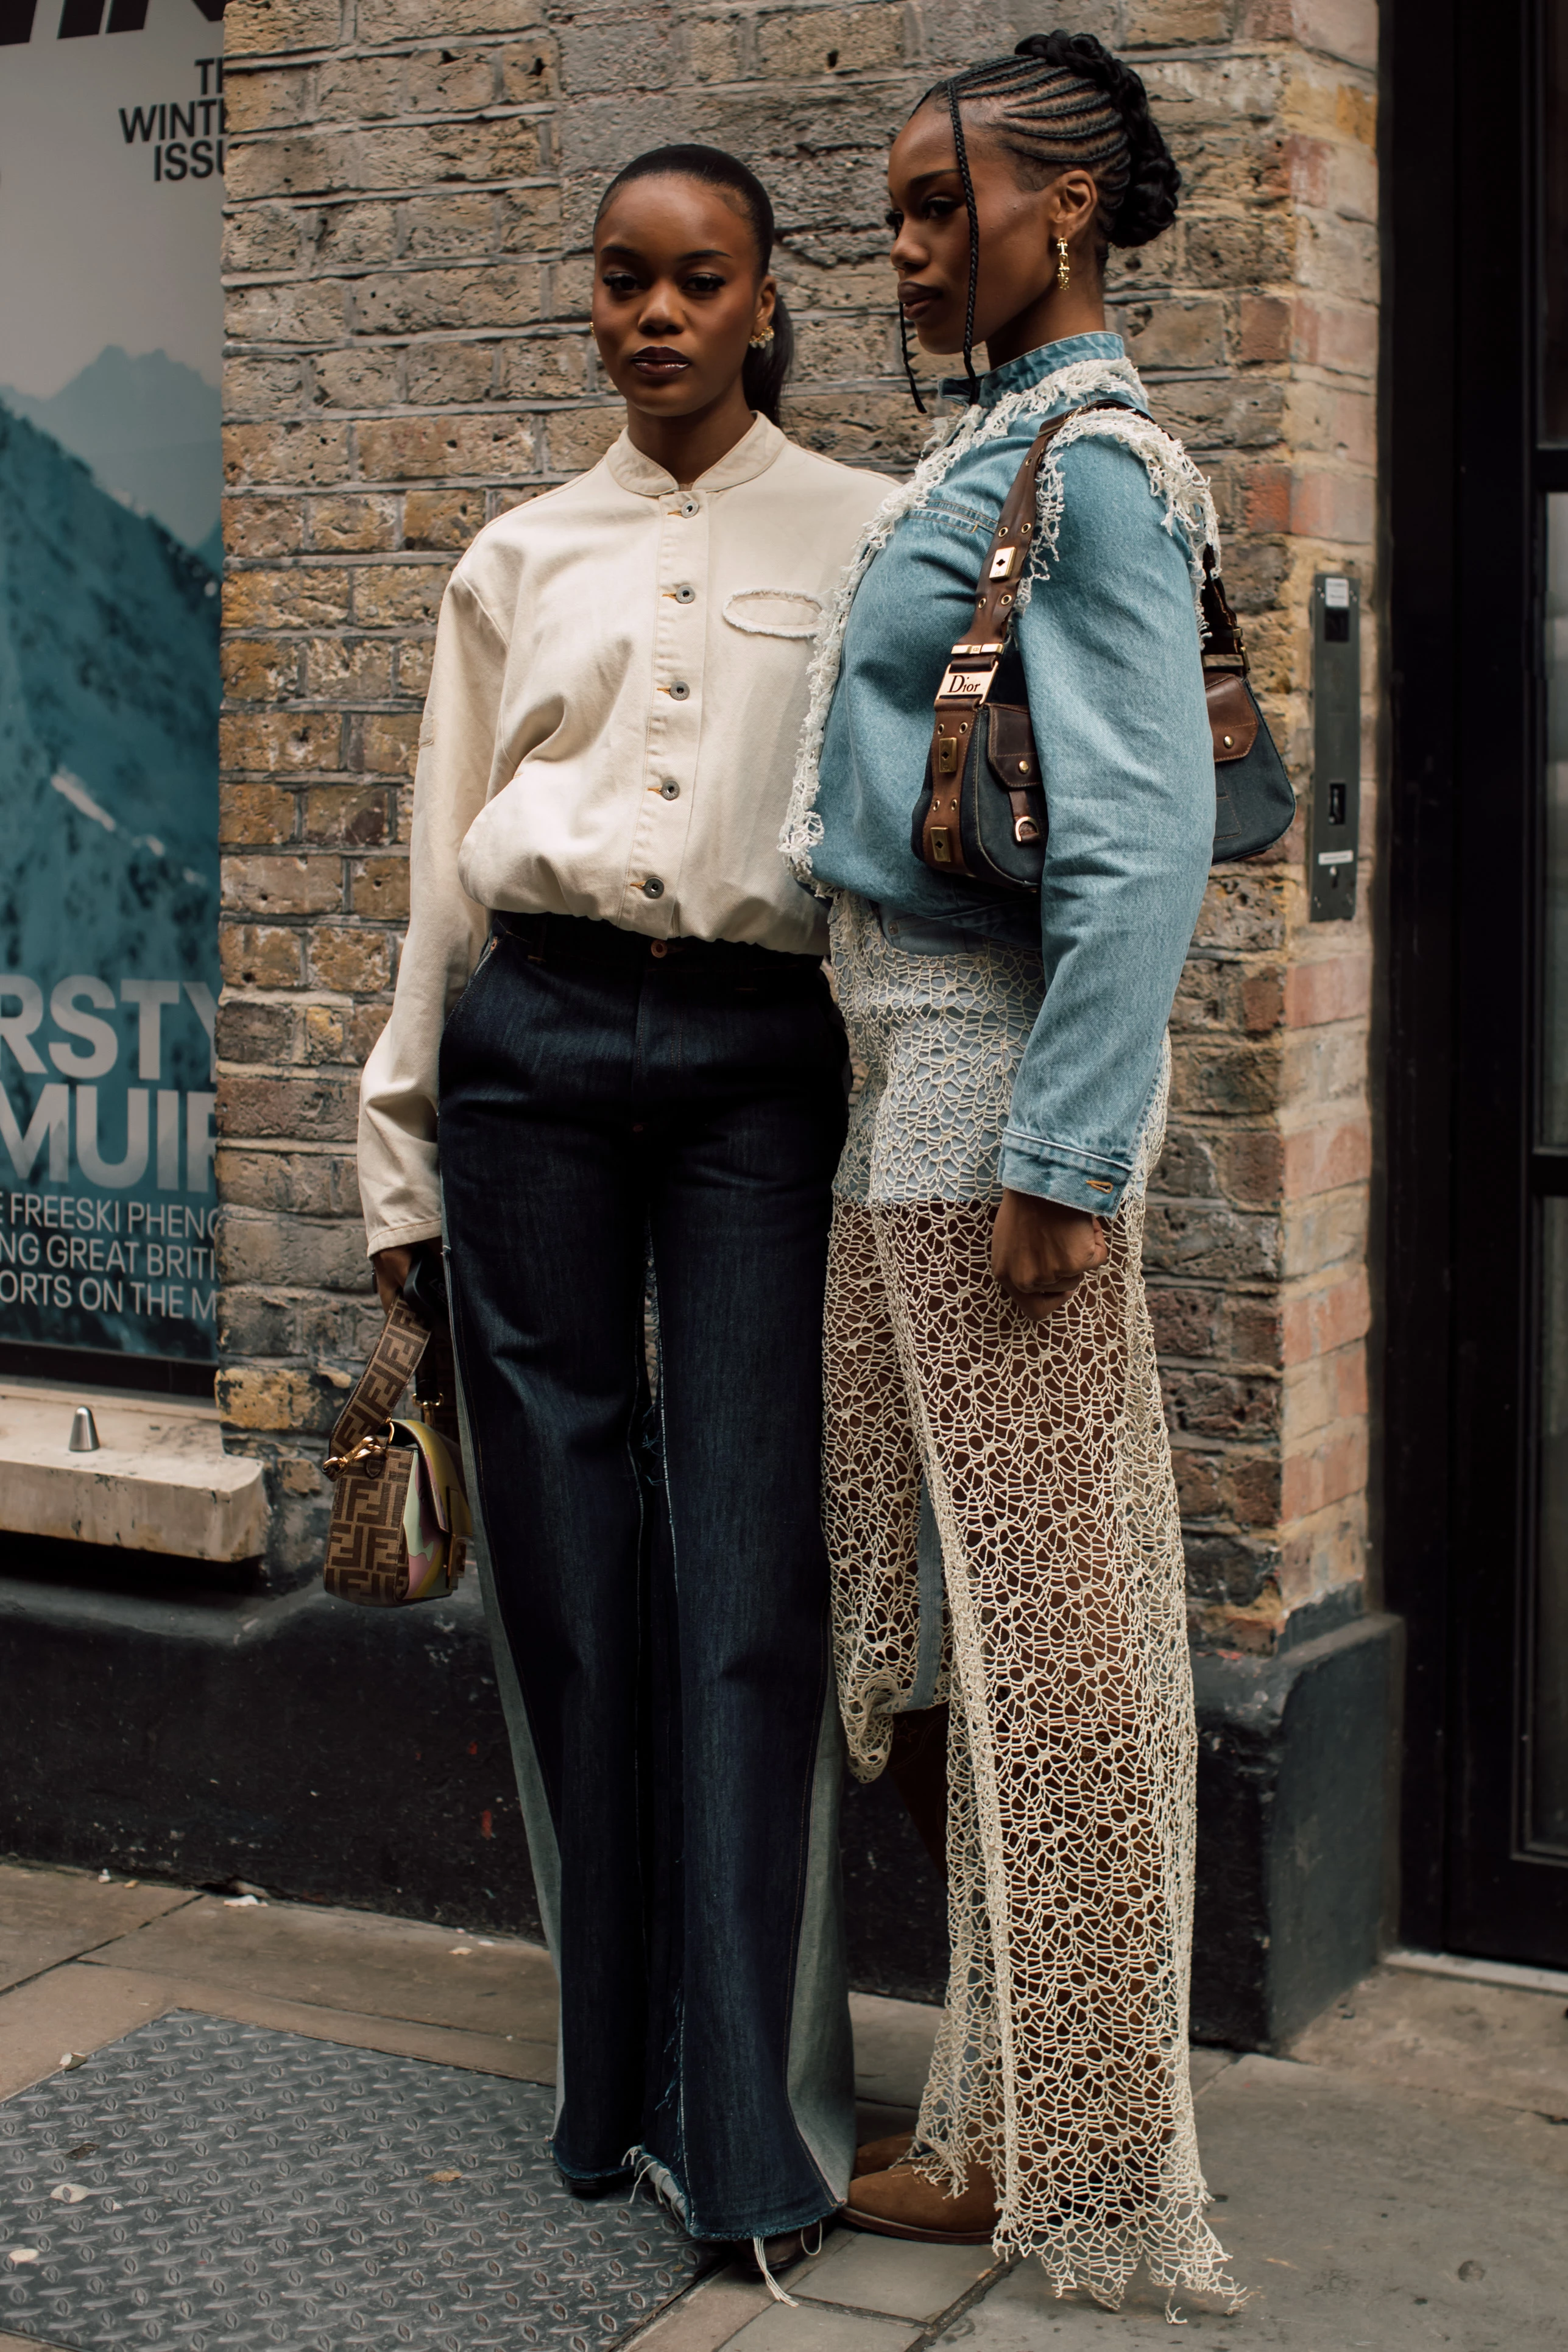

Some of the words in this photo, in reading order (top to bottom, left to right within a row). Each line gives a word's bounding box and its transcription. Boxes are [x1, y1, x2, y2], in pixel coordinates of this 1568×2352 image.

[947, 674, 981, 693] Dior
[10, 1192, 119, 1233] FREESKI
[46, 1235, 140, 1274] GREAT
[147, 1243, 221, 1282] BRITI
[0, 1270, 72, 1309] ORTS
[79, 1277, 122, 1313] ON
[130, 1281, 184, 1319] THE
